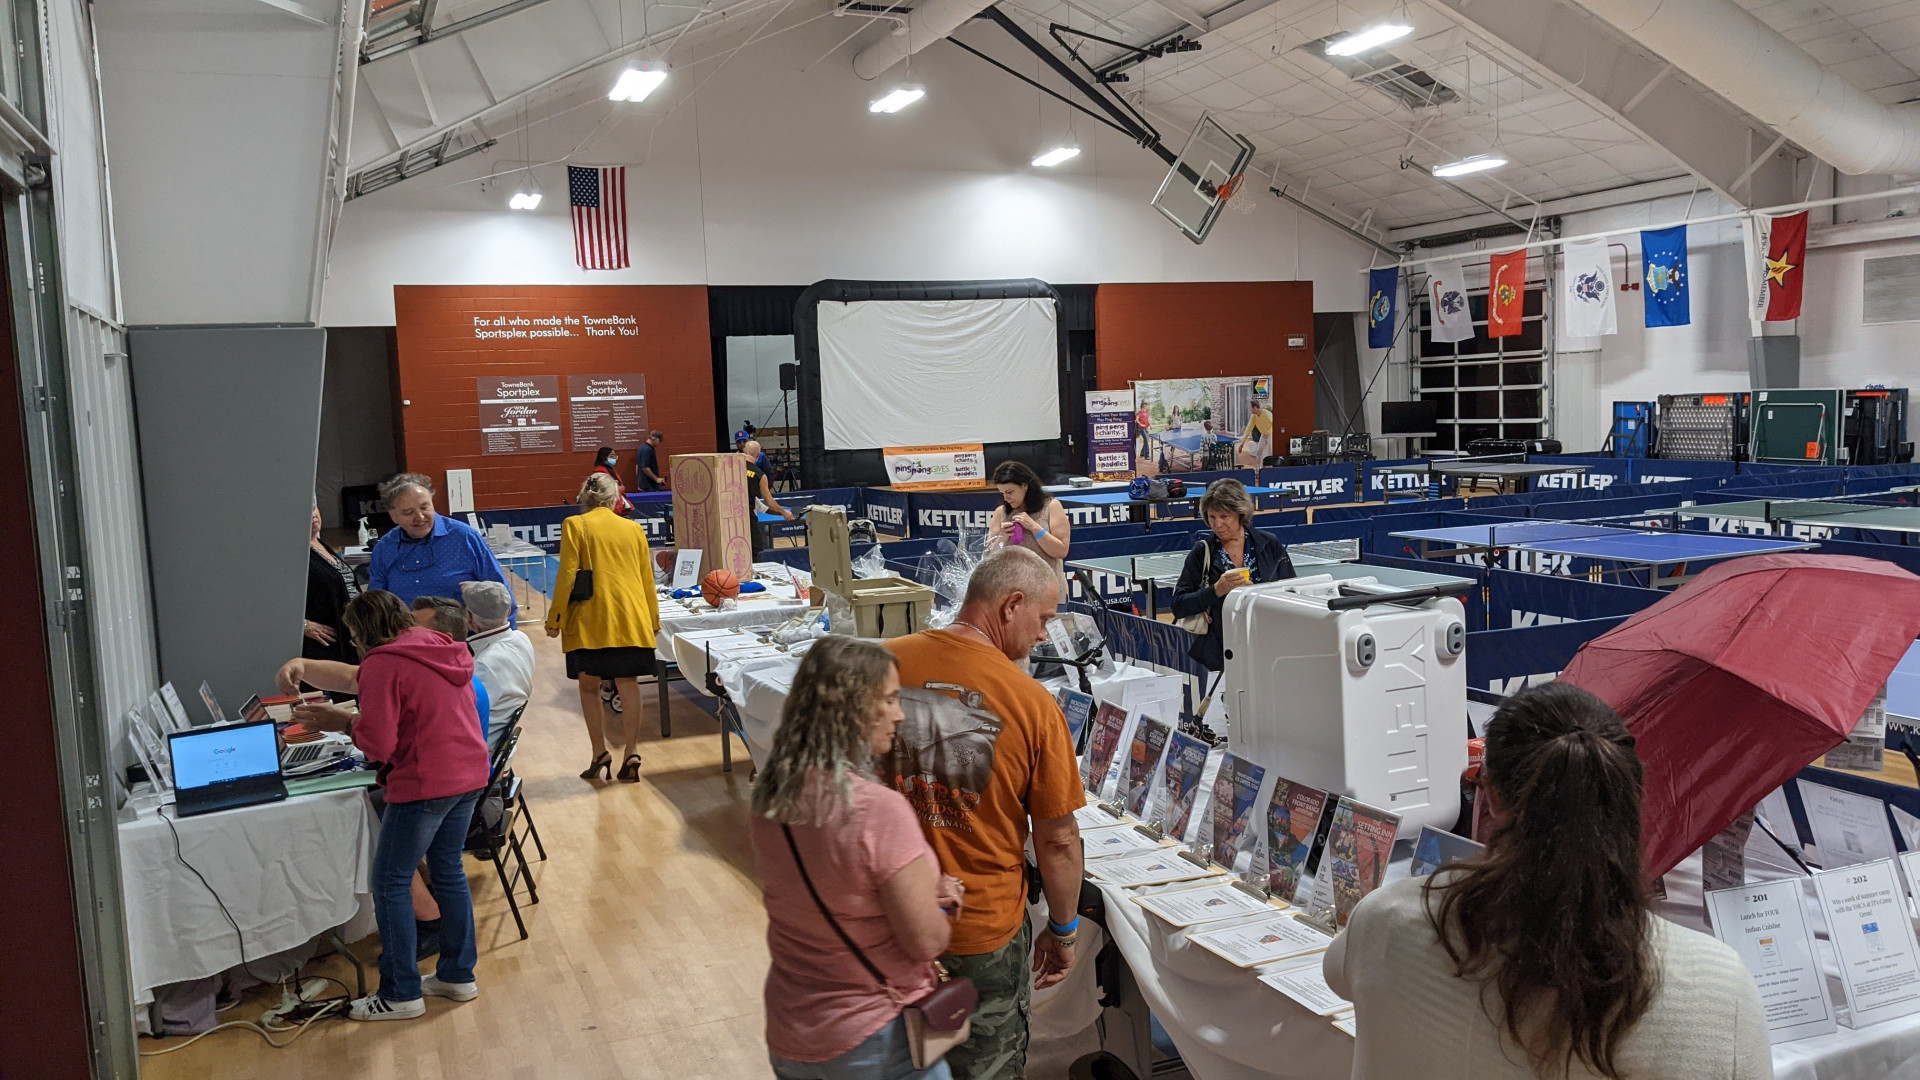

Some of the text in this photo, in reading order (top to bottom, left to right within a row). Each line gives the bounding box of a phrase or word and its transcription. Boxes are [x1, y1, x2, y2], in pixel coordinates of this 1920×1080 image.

[474, 315, 637, 326] For all who made the TowneBank
[475, 326, 639, 340] Sportsplex possible... Thank You!
[496, 388, 540, 398] Sportplex
[586, 385, 628, 396] Sportplex
[500, 406, 538, 418] Jordan
[867, 504, 904, 525] KETTLER
[213, 746, 236, 755] Google
[1296, 793, 1320, 806] COLORADO
[1292, 798, 1320, 814] FRONT RANGE
[933, 820, 973, 833] CANADA
[1357, 820, 1381, 834] SETTING
[1381, 828, 1393, 839] INN
[1852, 875, 1868, 884] 202
[1752, 893, 1768, 903] 201
[1740, 912, 1756, 920] Lunch
[1764, 909, 1780, 917] FOUR
[1745, 922, 1781, 934] Indian Cuisine
